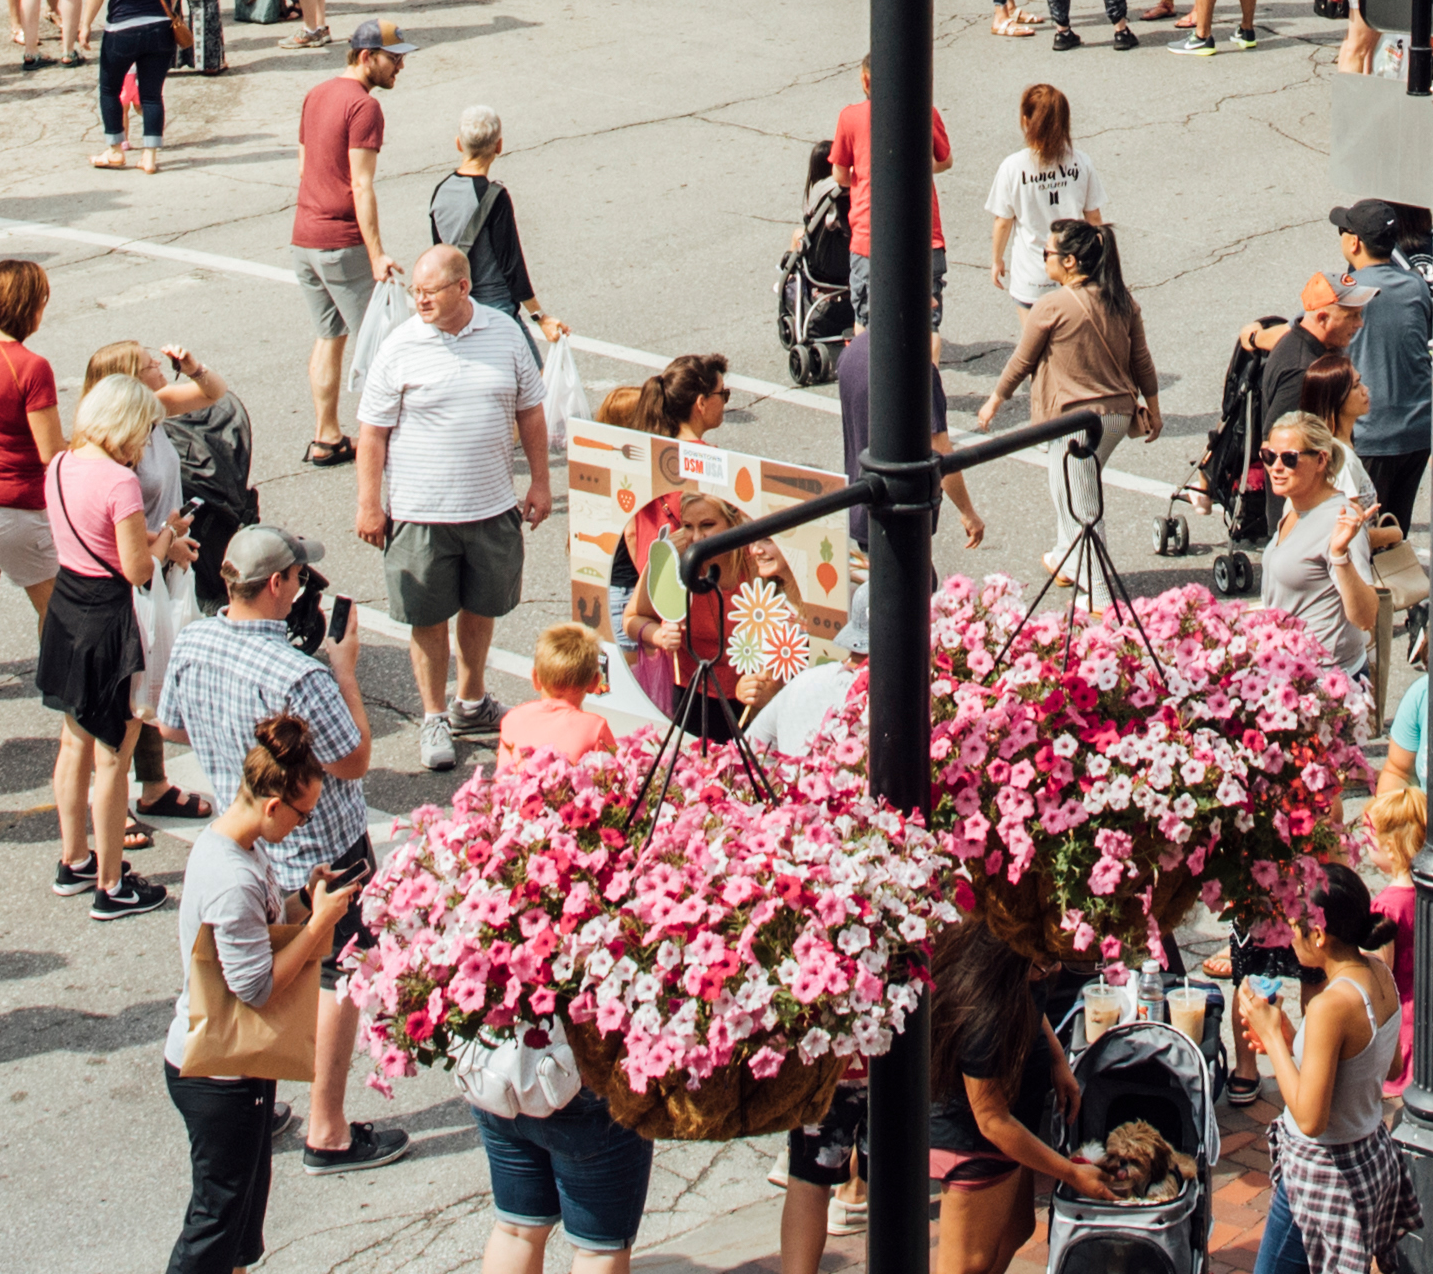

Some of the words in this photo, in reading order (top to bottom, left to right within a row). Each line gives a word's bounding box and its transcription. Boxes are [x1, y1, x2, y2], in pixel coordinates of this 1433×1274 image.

[1022, 171, 1056, 186] Luna
[684, 457, 704, 474] DSM
[705, 461, 724, 479] USA
